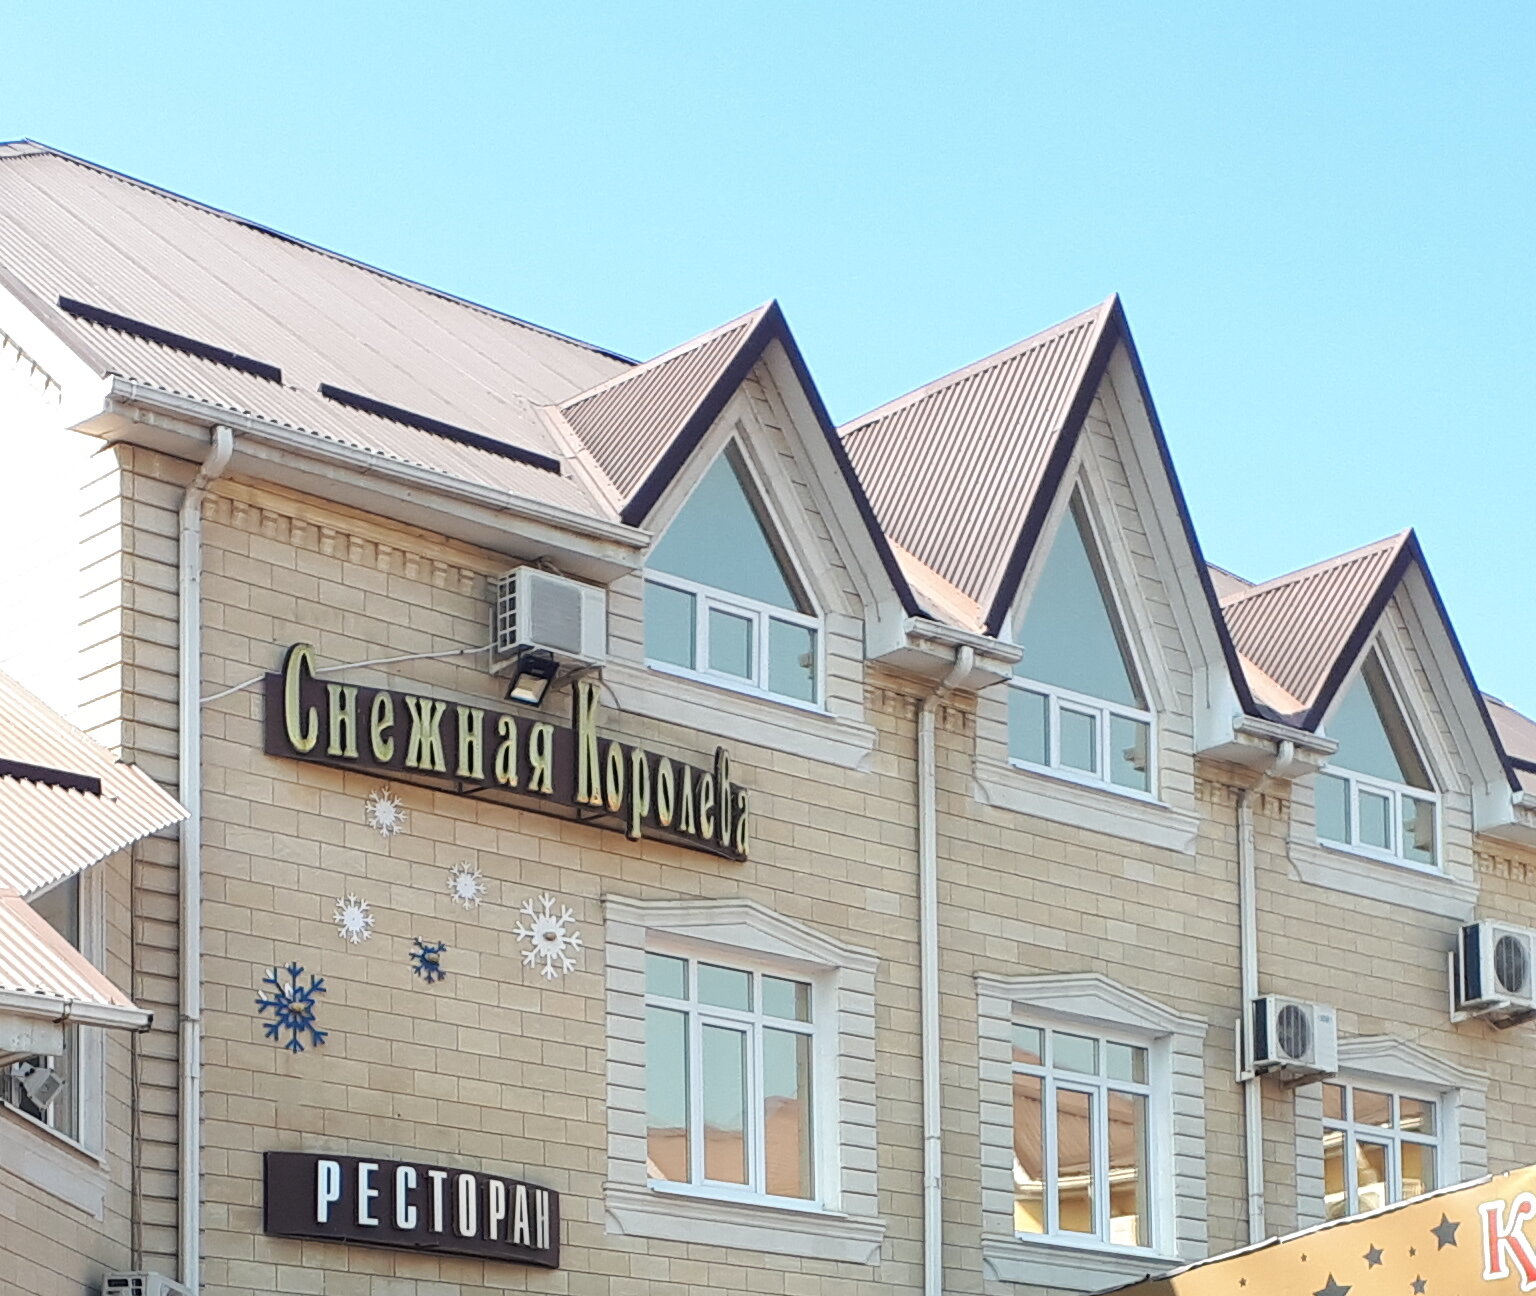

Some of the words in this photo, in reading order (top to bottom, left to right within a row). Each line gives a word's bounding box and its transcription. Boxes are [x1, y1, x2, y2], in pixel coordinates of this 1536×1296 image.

[283, 642, 555, 794] Снежная
[574, 680, 750, 857] Королева
[317, 1159, 551, 1250] РЕСТОРАН
